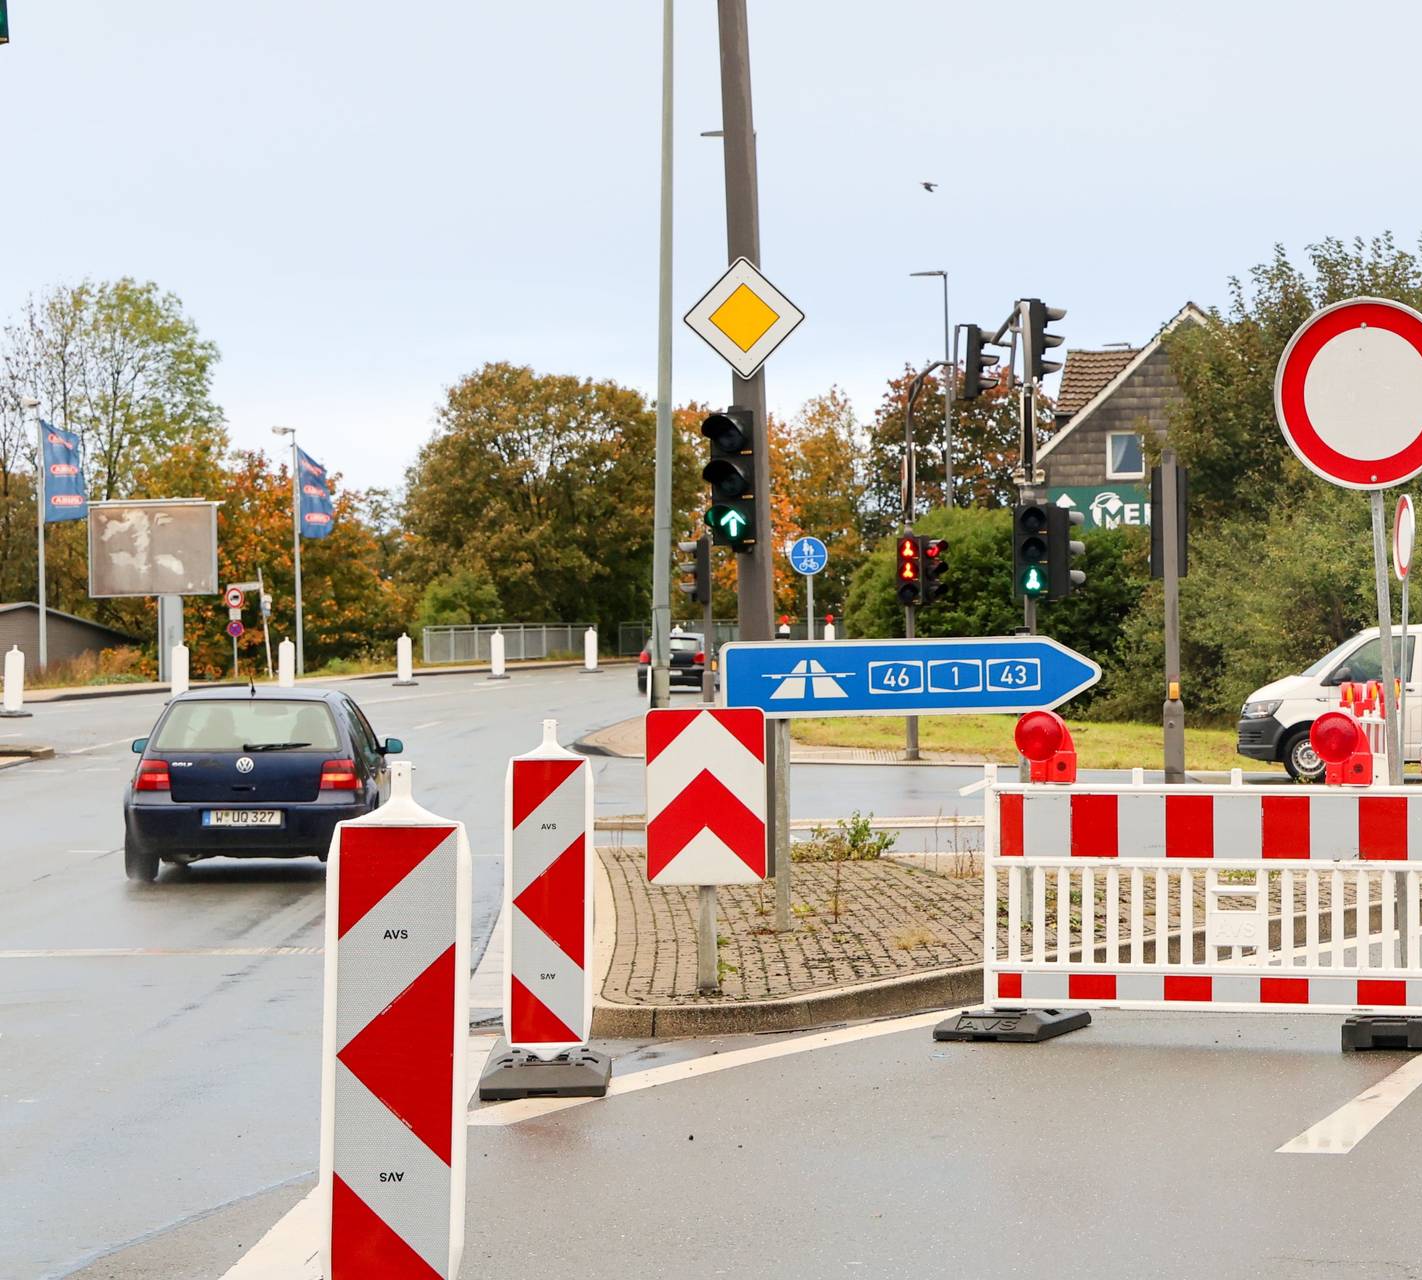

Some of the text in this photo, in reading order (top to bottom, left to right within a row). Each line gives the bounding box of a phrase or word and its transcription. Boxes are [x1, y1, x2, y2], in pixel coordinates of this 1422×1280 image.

[883, 665, 1027, 687] 46 1 43
[215, 811, 275, 823] W UQ 327
[383, 929, 408, 940] AVS
[959, 1017, 1020, 1031] AVS
[379, 1171, 405, 1183] AVS
